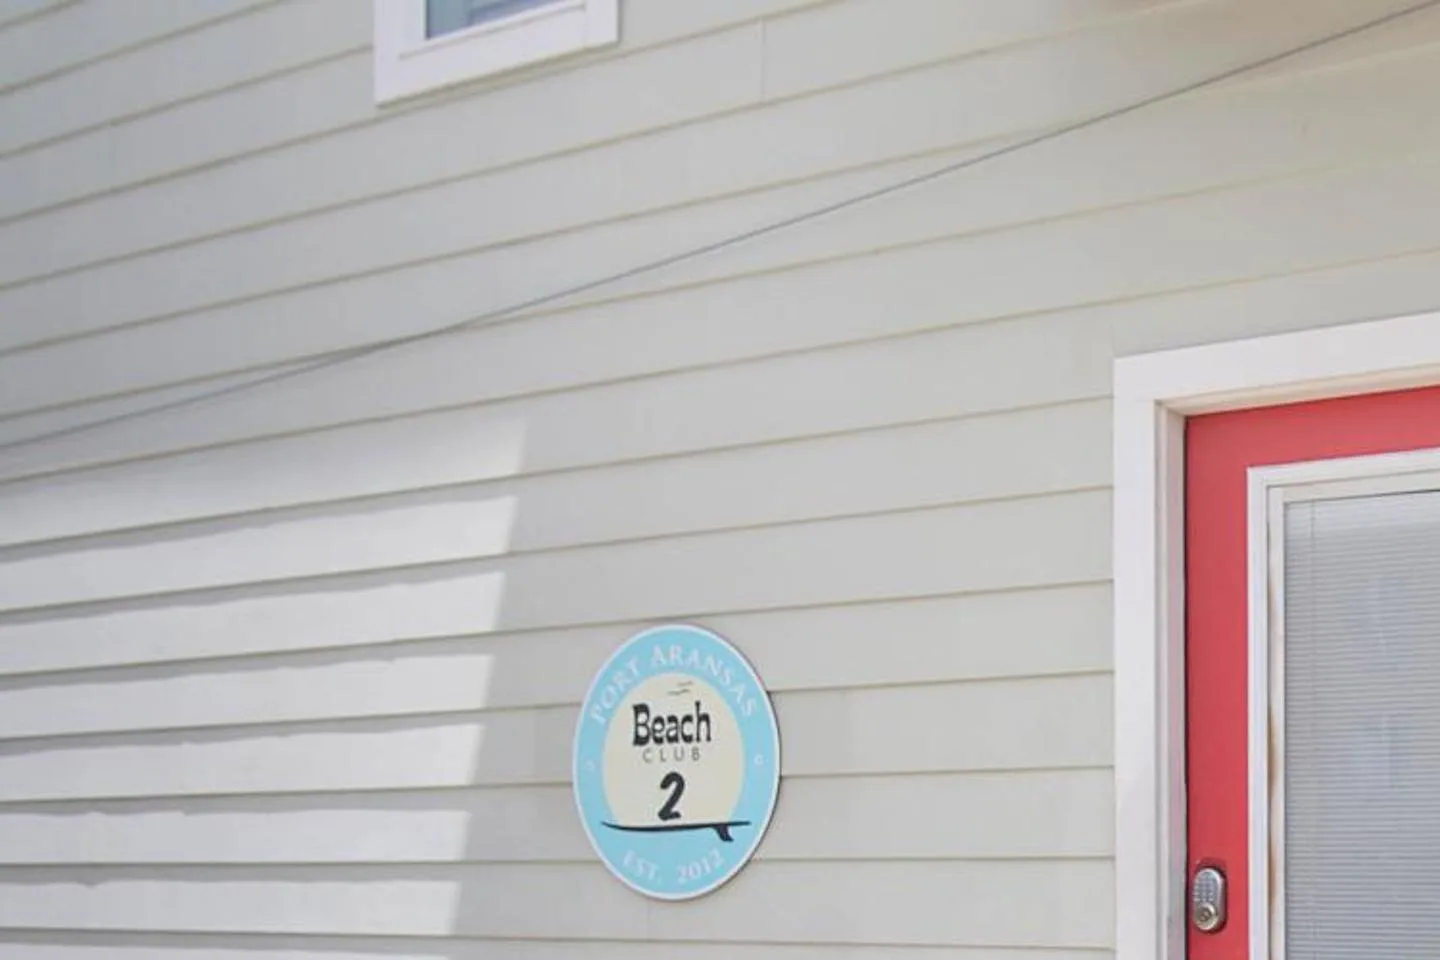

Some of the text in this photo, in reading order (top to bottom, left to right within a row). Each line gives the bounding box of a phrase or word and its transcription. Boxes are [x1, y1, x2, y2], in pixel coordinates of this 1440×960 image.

[590, 645, 756, 725] PORT ARANSAS
[632, 700, 711, 746] Beach
[642, 748, 702, 763] CLUB
[658, 771, 685, 821] 2
